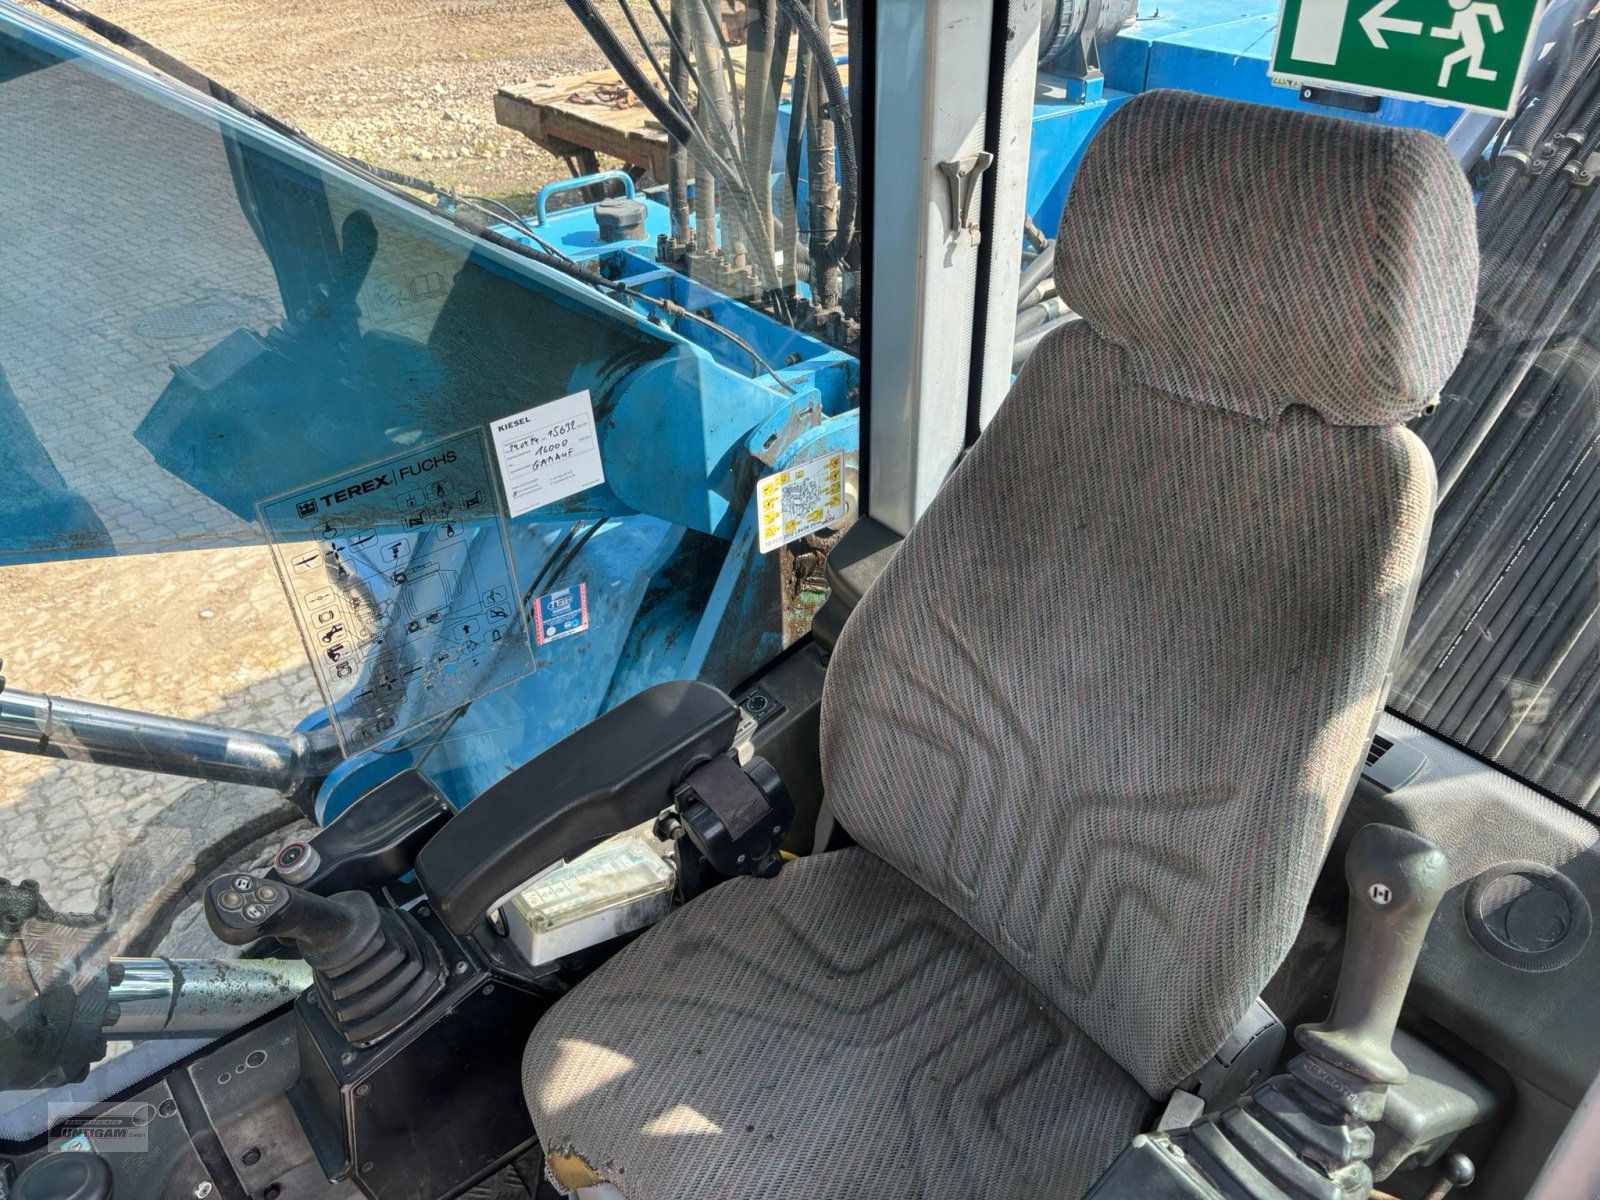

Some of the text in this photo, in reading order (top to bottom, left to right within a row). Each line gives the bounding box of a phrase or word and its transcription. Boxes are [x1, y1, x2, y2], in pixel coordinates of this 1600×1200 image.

[498, 417, 531, 432] KIESEL
[547, 419, 578, 438] 15632
[534, 438, 569, 457] 16000
[319, 450, 457, 507] TEREX FUCHS
